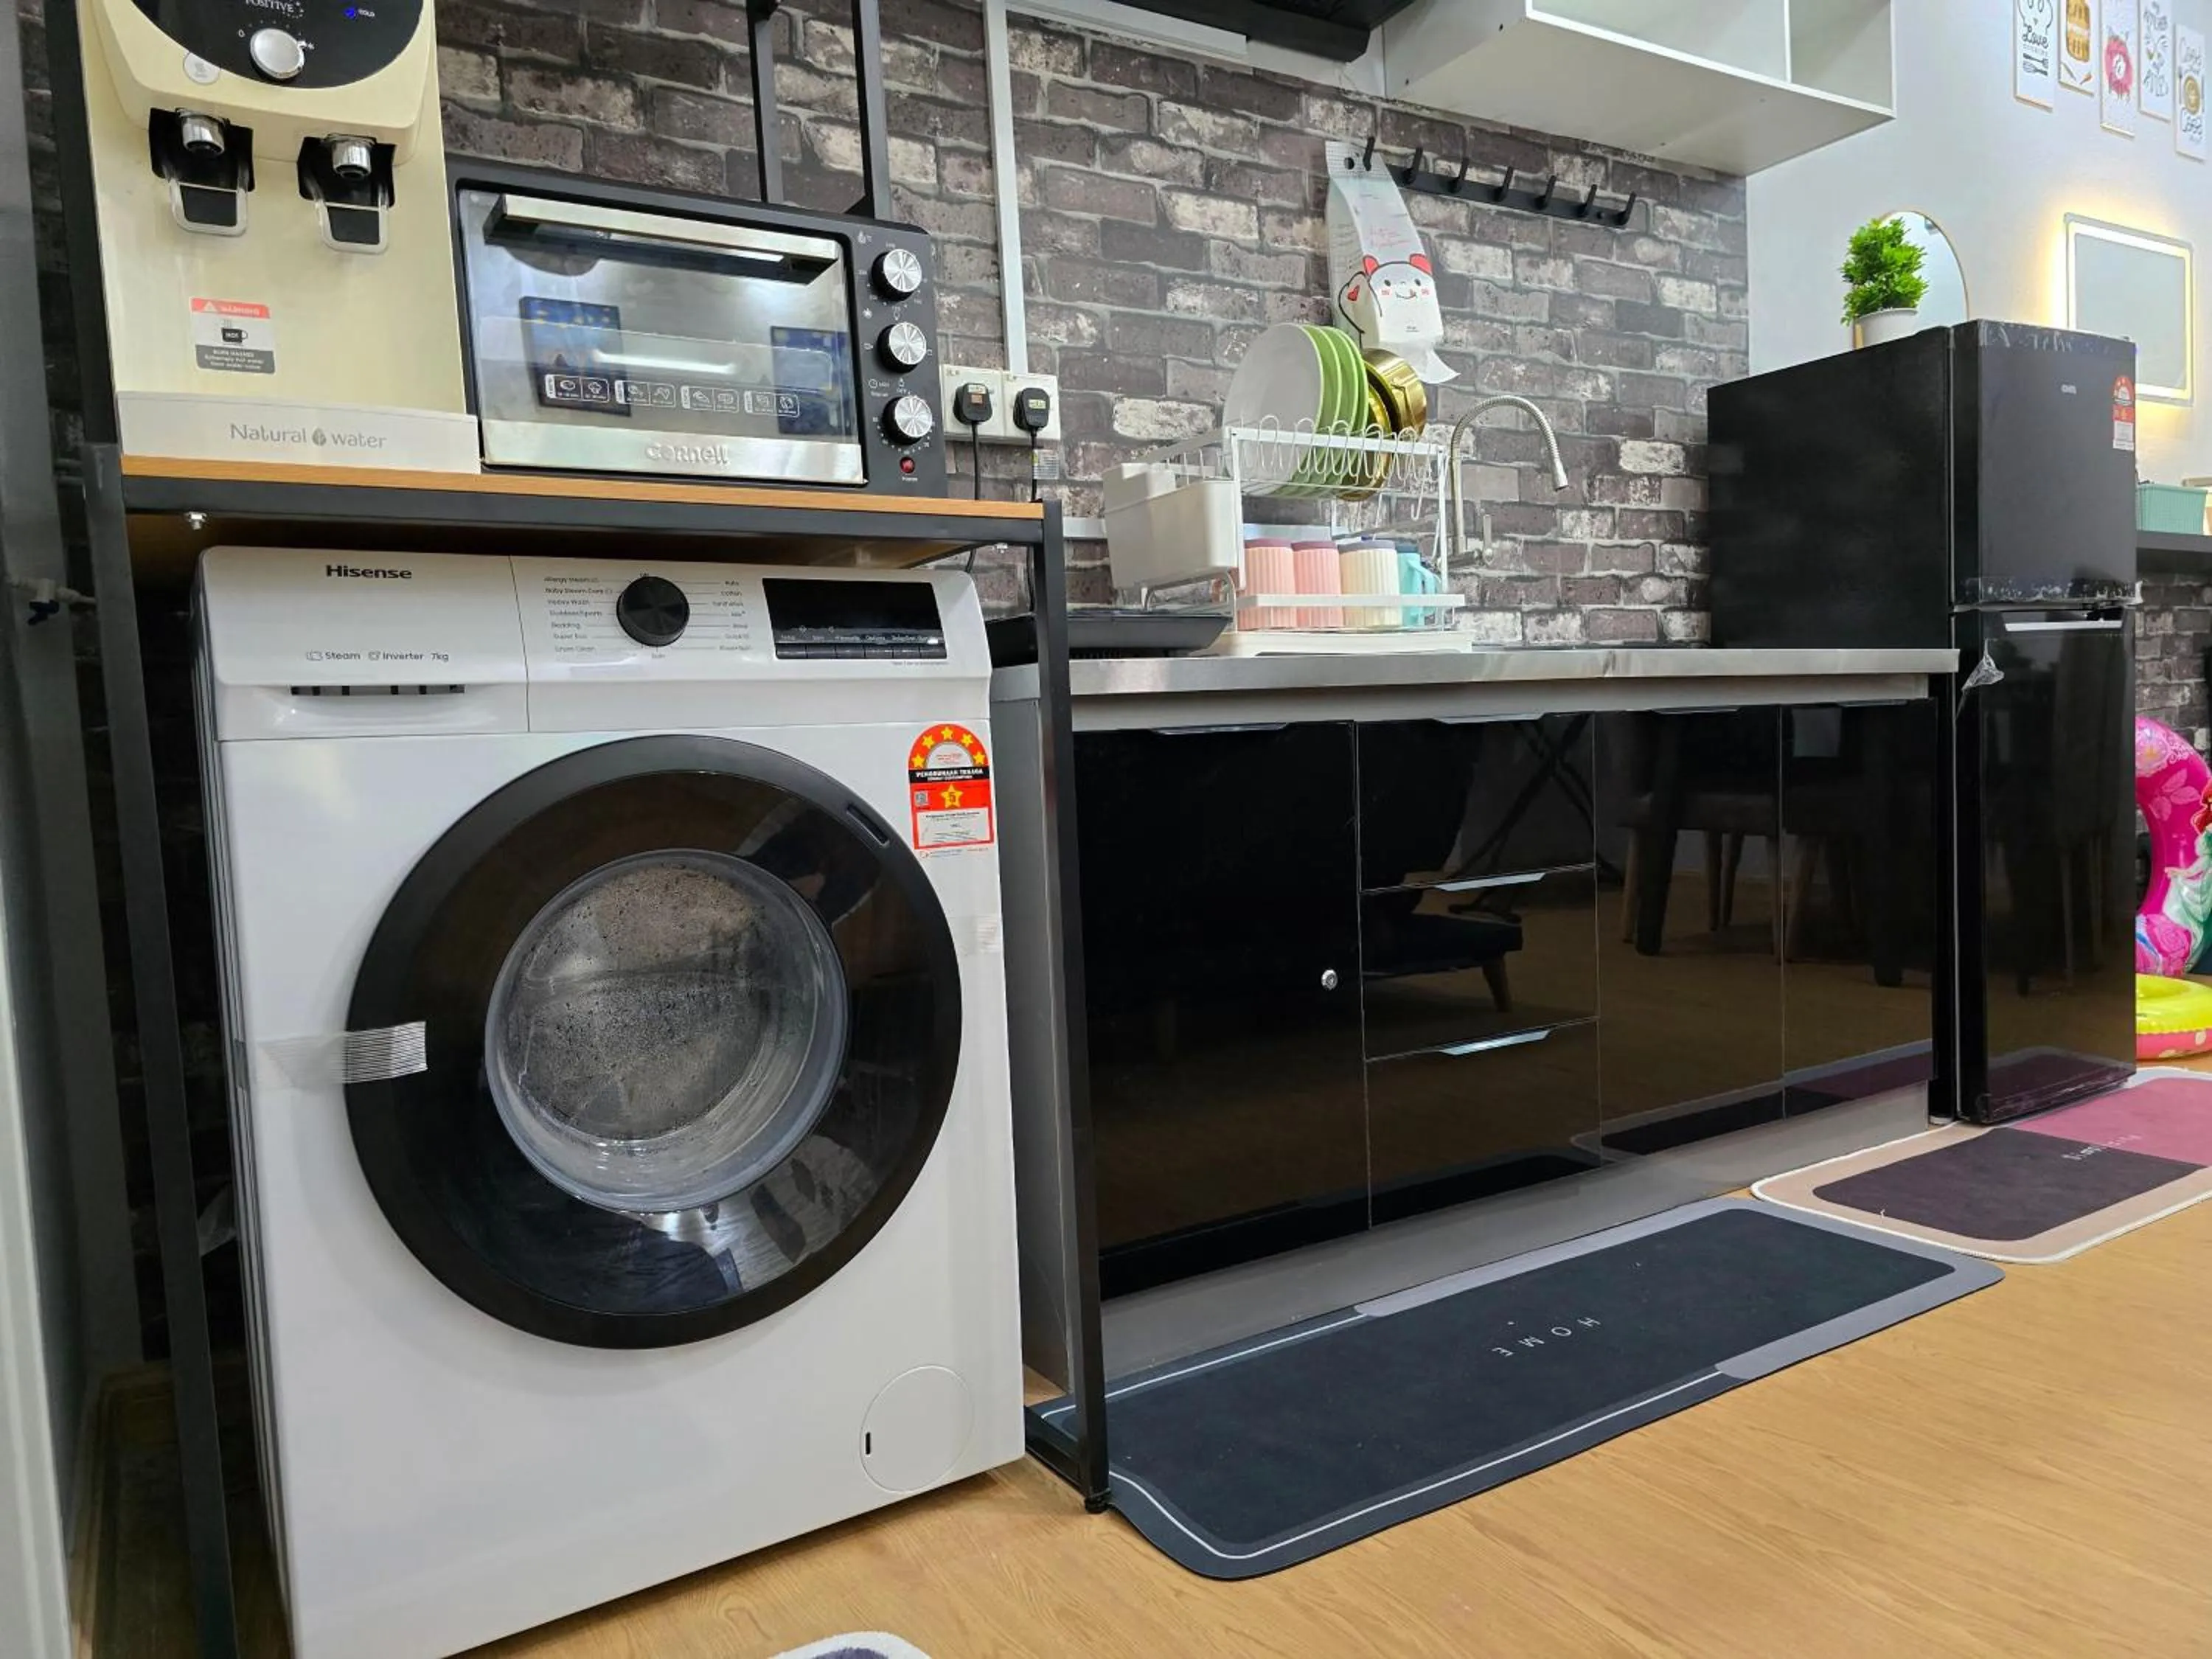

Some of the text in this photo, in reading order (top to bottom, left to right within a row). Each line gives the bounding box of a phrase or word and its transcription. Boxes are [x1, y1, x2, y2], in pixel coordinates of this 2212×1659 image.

[2022, 25, 2049, 49] Love
[229, 423, 389, 449] Natural water
[326, 565, 412, 579] Hisense
[325, 651, 449, 663] Steam Inverter 7kg
[948, 791, 956, 803] 5
[1492, 1317, 1601, 1357] HOME
